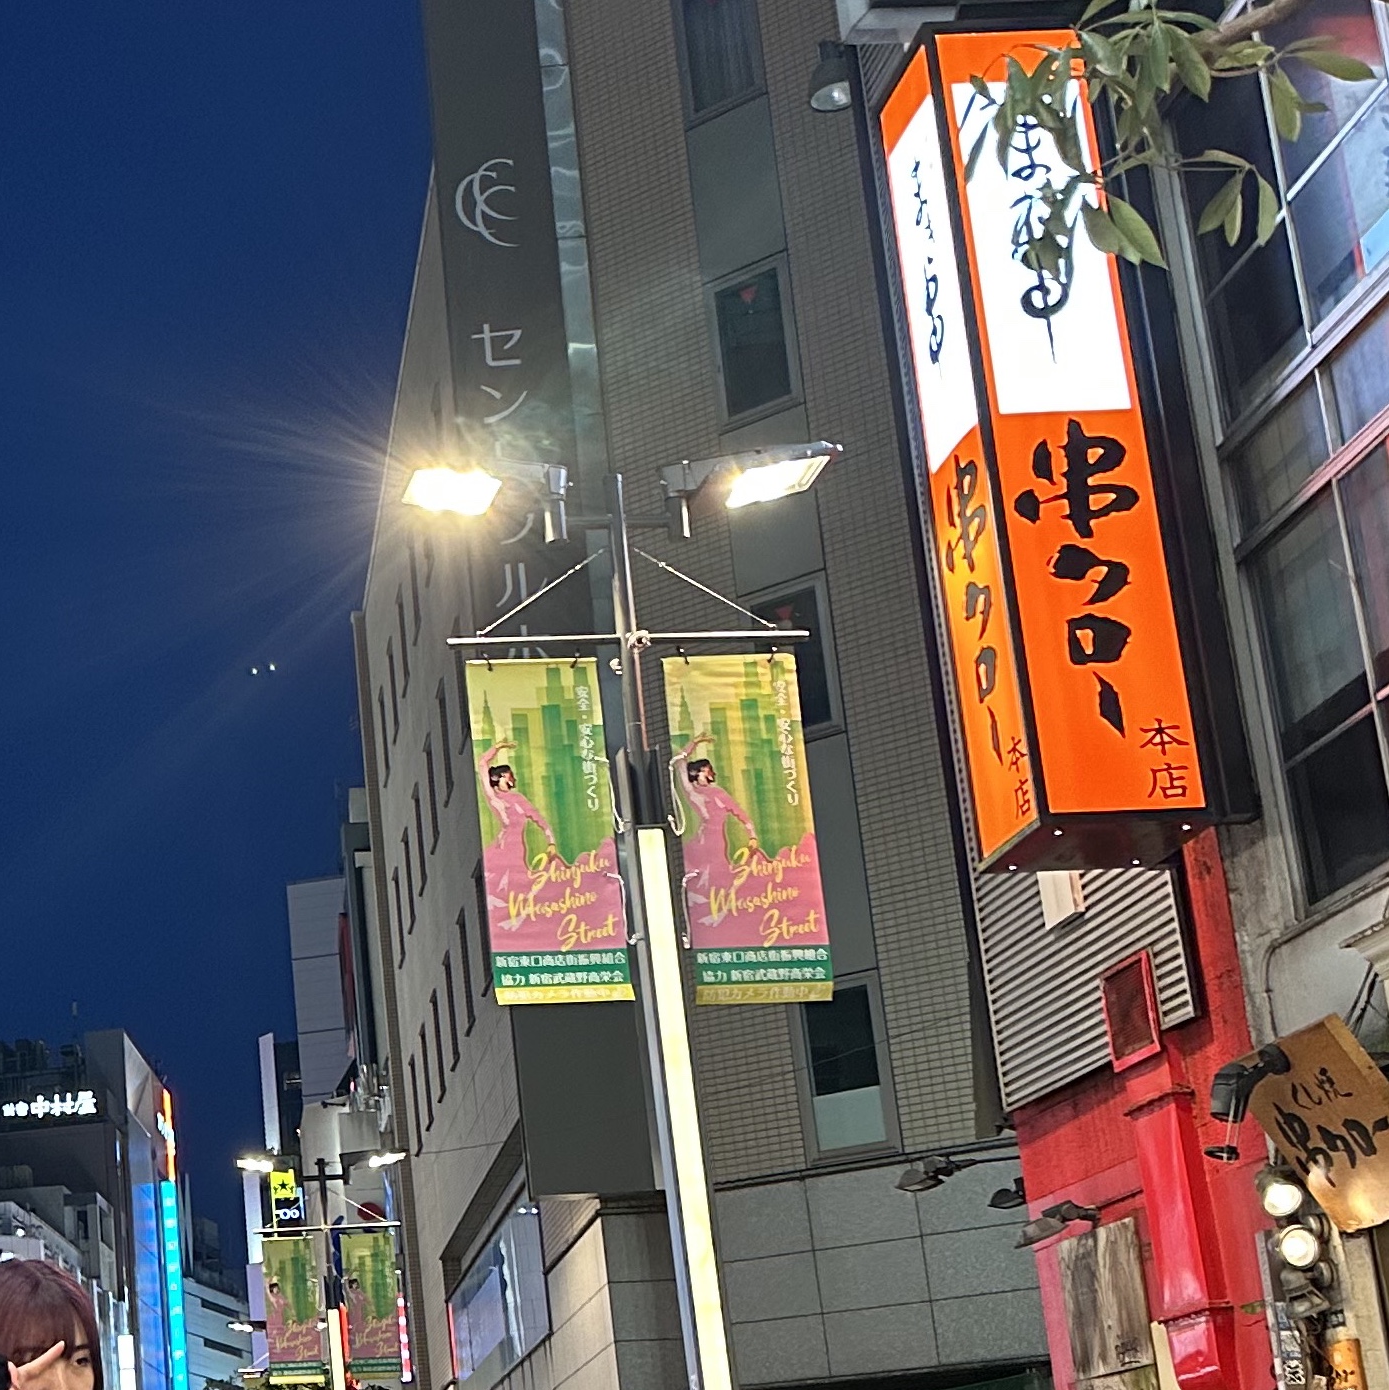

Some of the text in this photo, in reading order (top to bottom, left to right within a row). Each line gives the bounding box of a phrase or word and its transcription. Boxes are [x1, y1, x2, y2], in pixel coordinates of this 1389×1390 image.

[1012, 418, 1140, 739] 串クロー
[945, 454, 1004, 766] 串クロー
[1139, 717, 1190, 800] 本店
[1006, 735, 1034, 823] 本店
[527, 849, 611, 889] Shinjuku
[729, 845, 812, 884] Shinjuku
[557, 913, 619, 952] Street
[758, 908, 820, 948] Street
[495, 951, 626, 968] 新宿東口商店街振興組合
